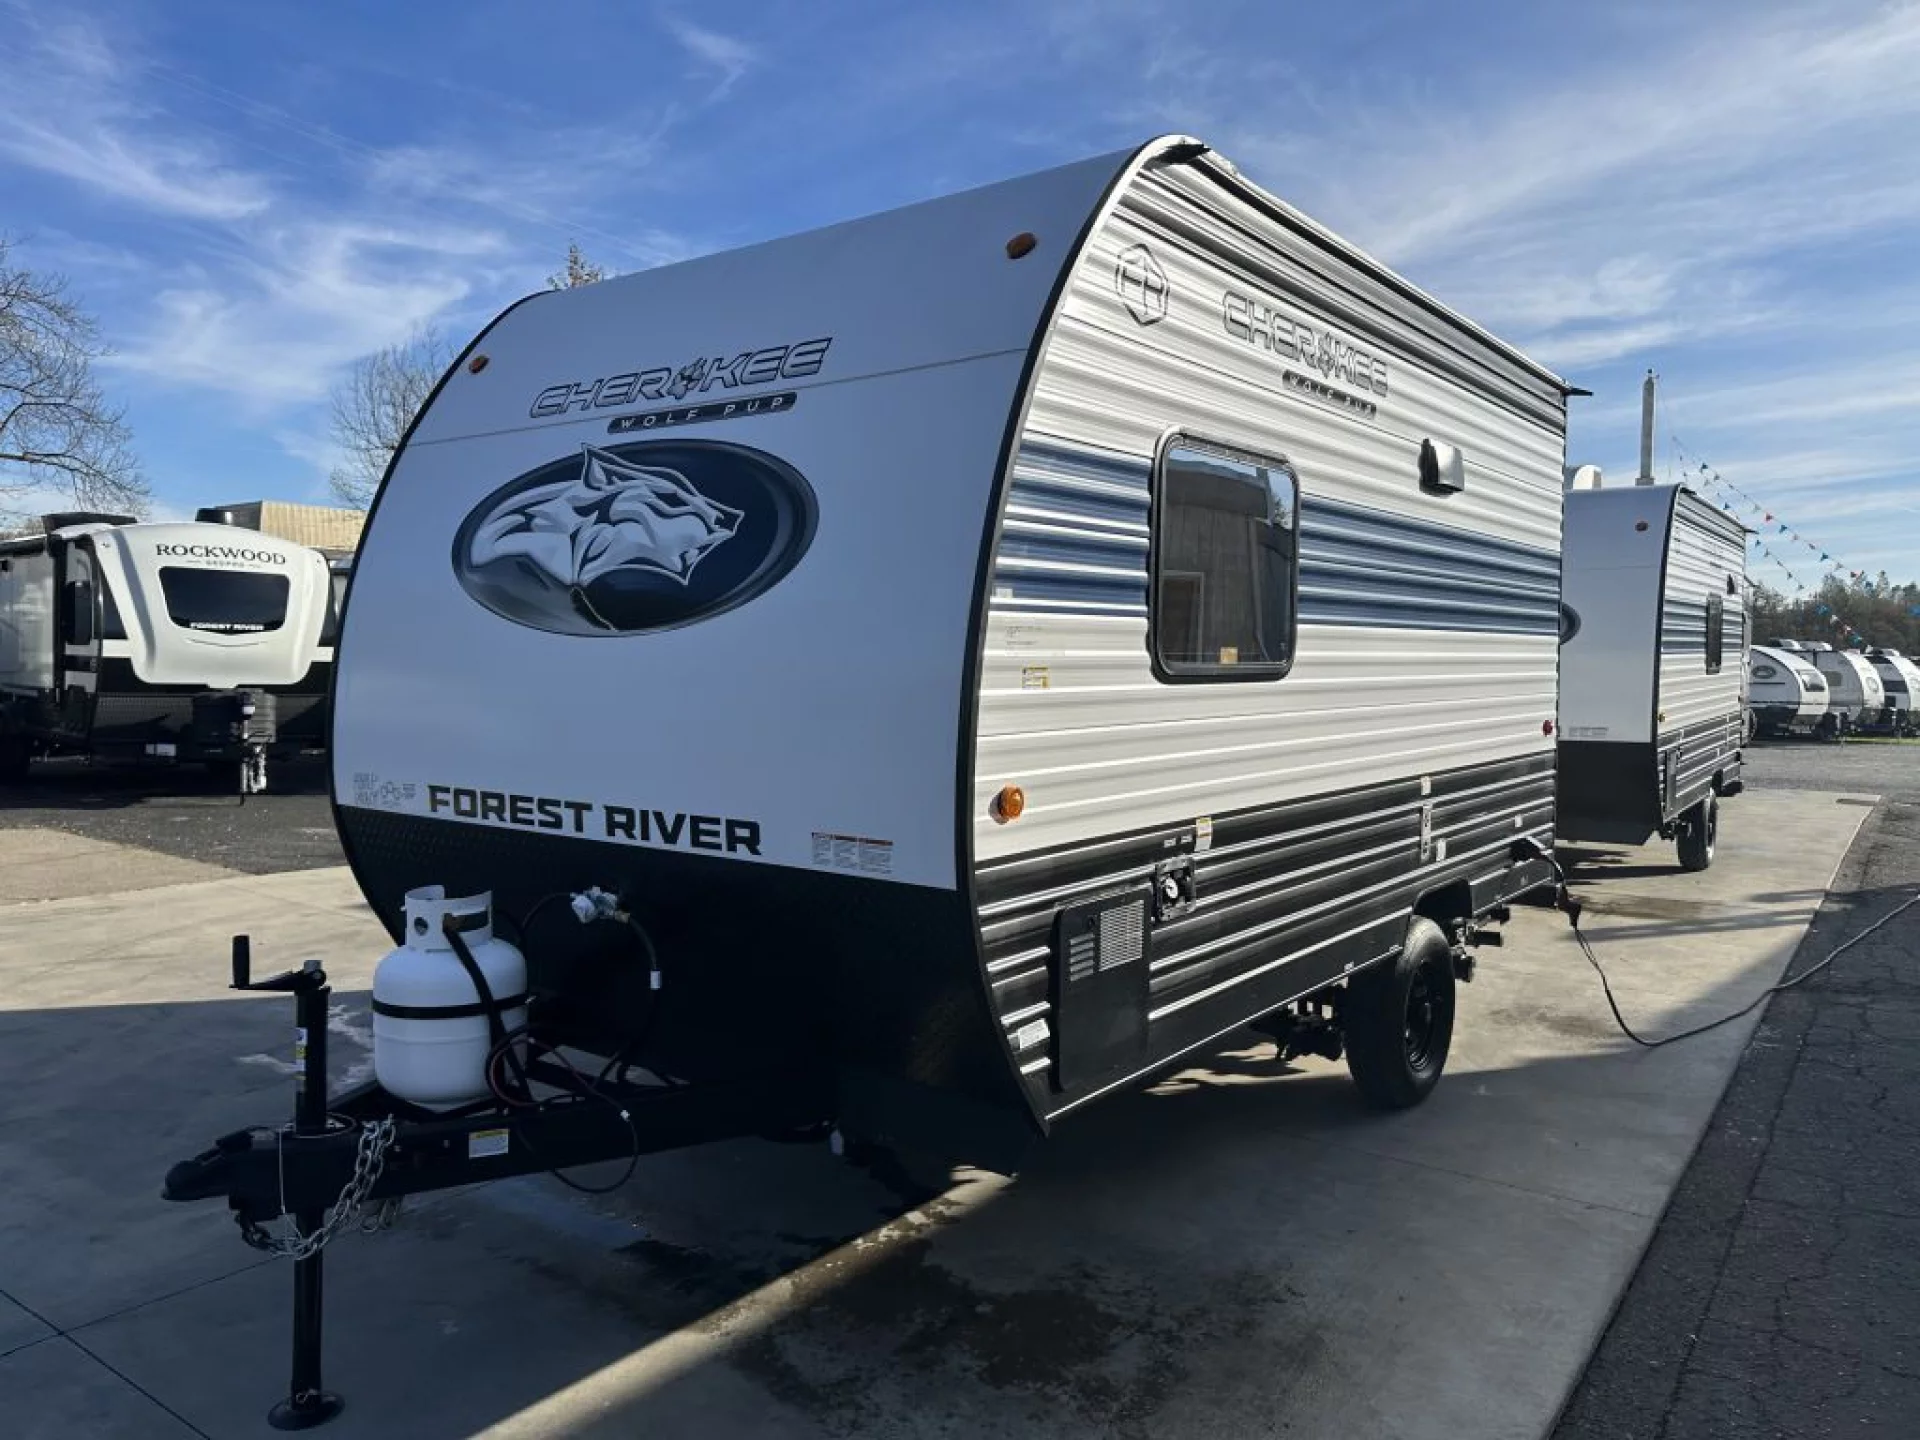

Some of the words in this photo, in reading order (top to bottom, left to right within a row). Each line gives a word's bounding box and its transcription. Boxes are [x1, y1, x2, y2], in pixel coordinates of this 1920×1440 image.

[620, 407, 698, 429] WOLF
[723, 397, 783, 416] PUP
[156, 544, 286, 564] ROCKWOOD
[428, 785, 593, 833] FOREST
[604, 805, 761, 855] RIVER
